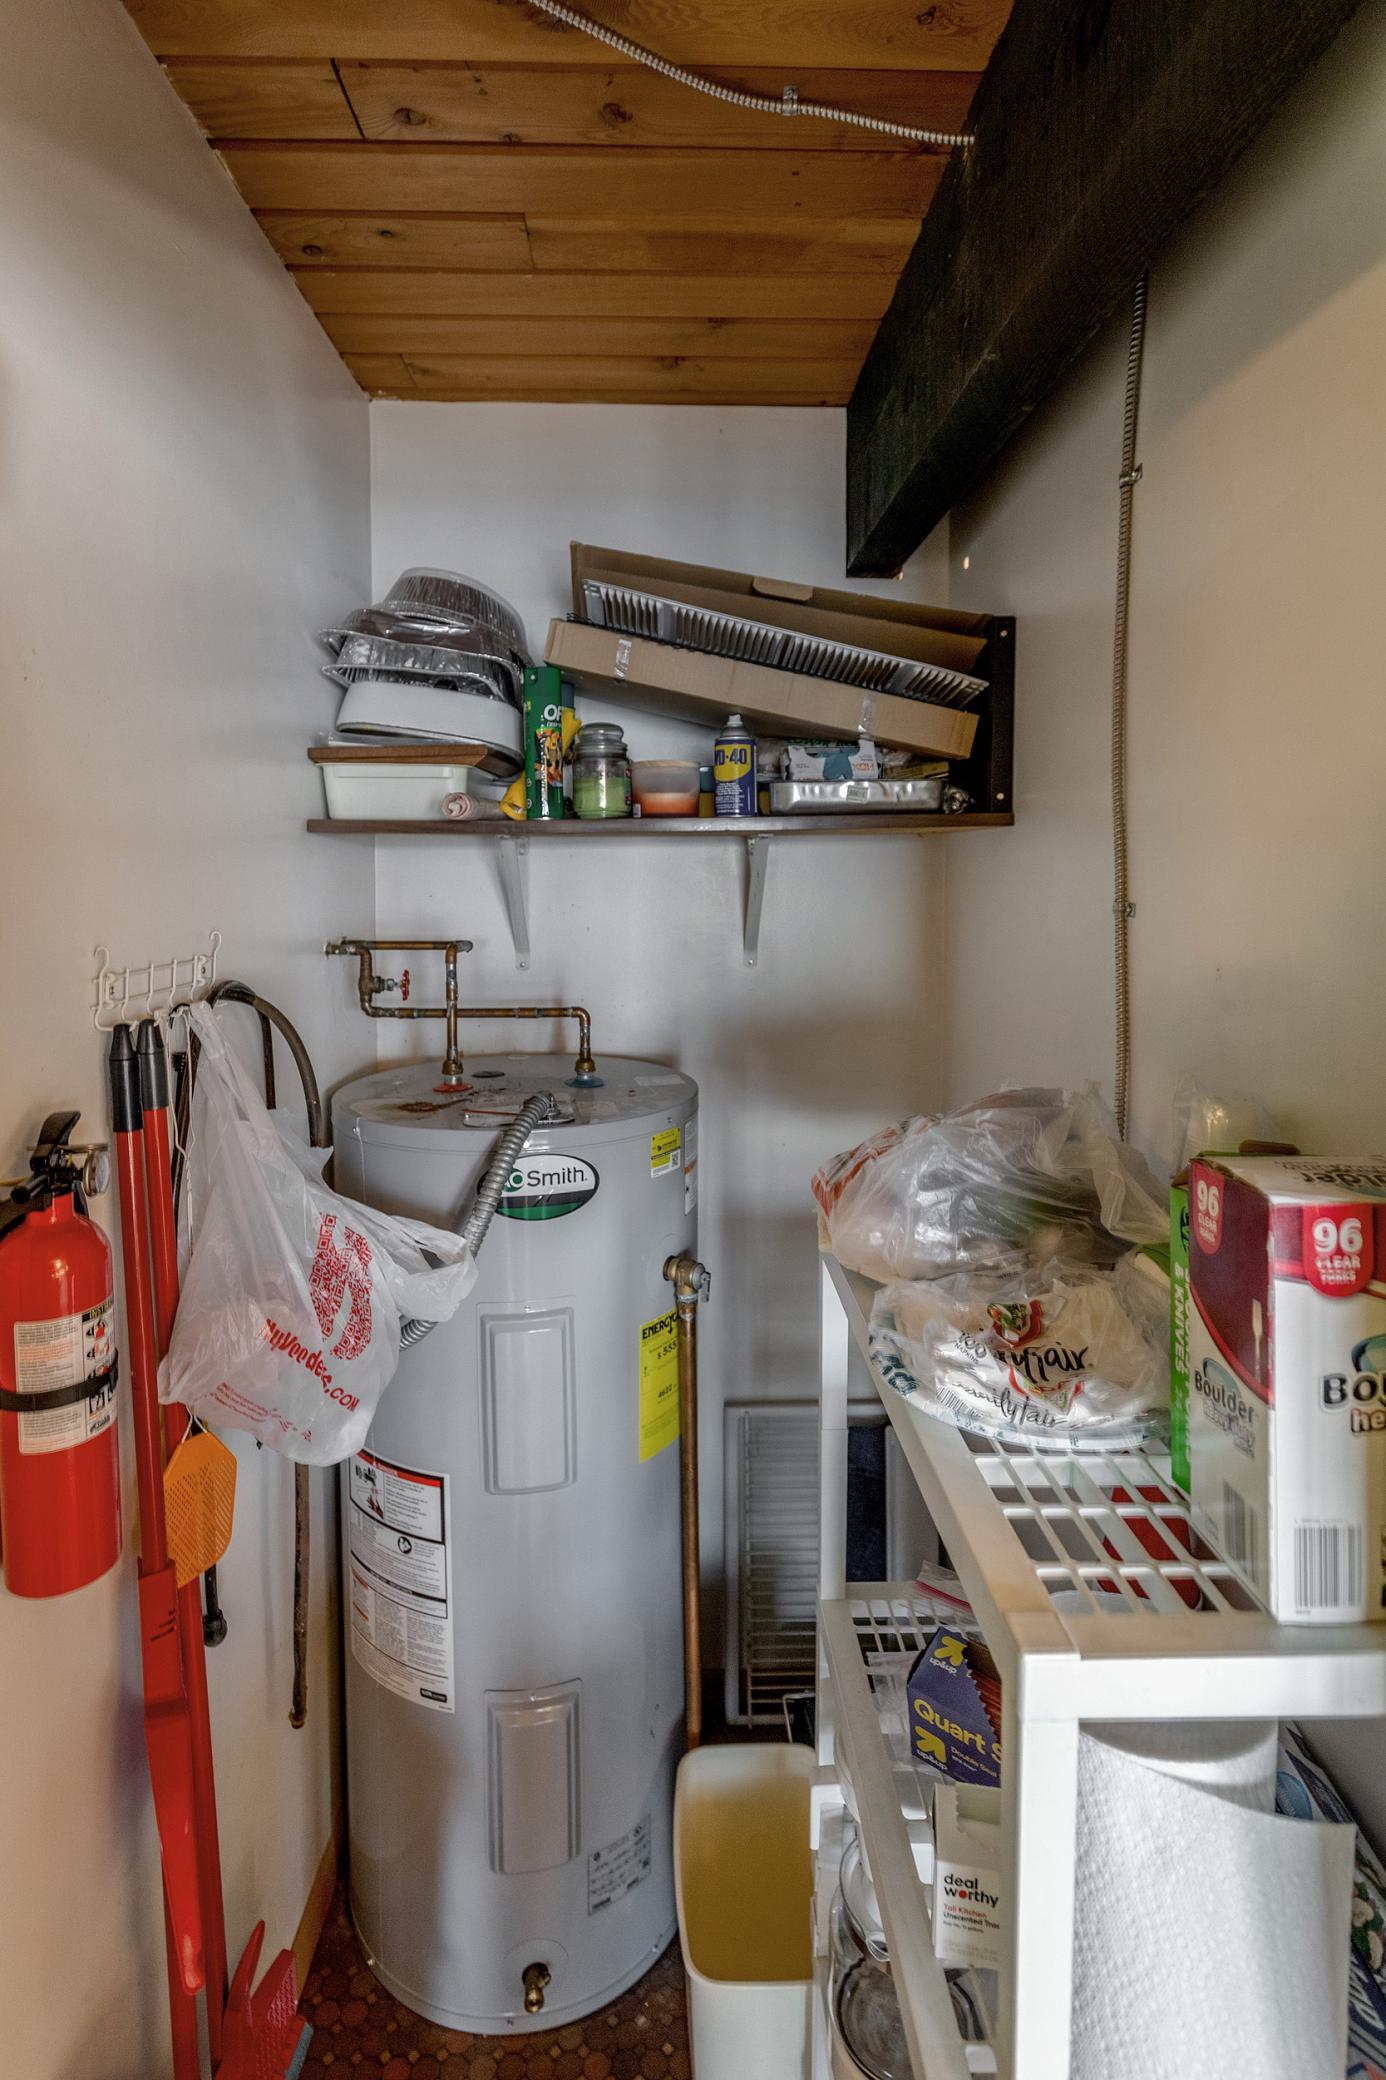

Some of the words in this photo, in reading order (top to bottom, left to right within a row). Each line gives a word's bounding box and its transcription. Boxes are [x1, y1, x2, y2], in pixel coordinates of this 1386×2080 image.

[1197, 1180, 1219, 1218] 96
[1312, 1217, 1363, 1254] 96
[1175, 1285, 1185, 1375] KNIVES
[1195, 1369, 1254, 1423] Boulder
[929, 1656, 957, 1676] up&up
[914, 1699, 986, 1755] Quart
[944, 1873, 978, 1890] deal
[944, 1886, 999, 1908] worthy
